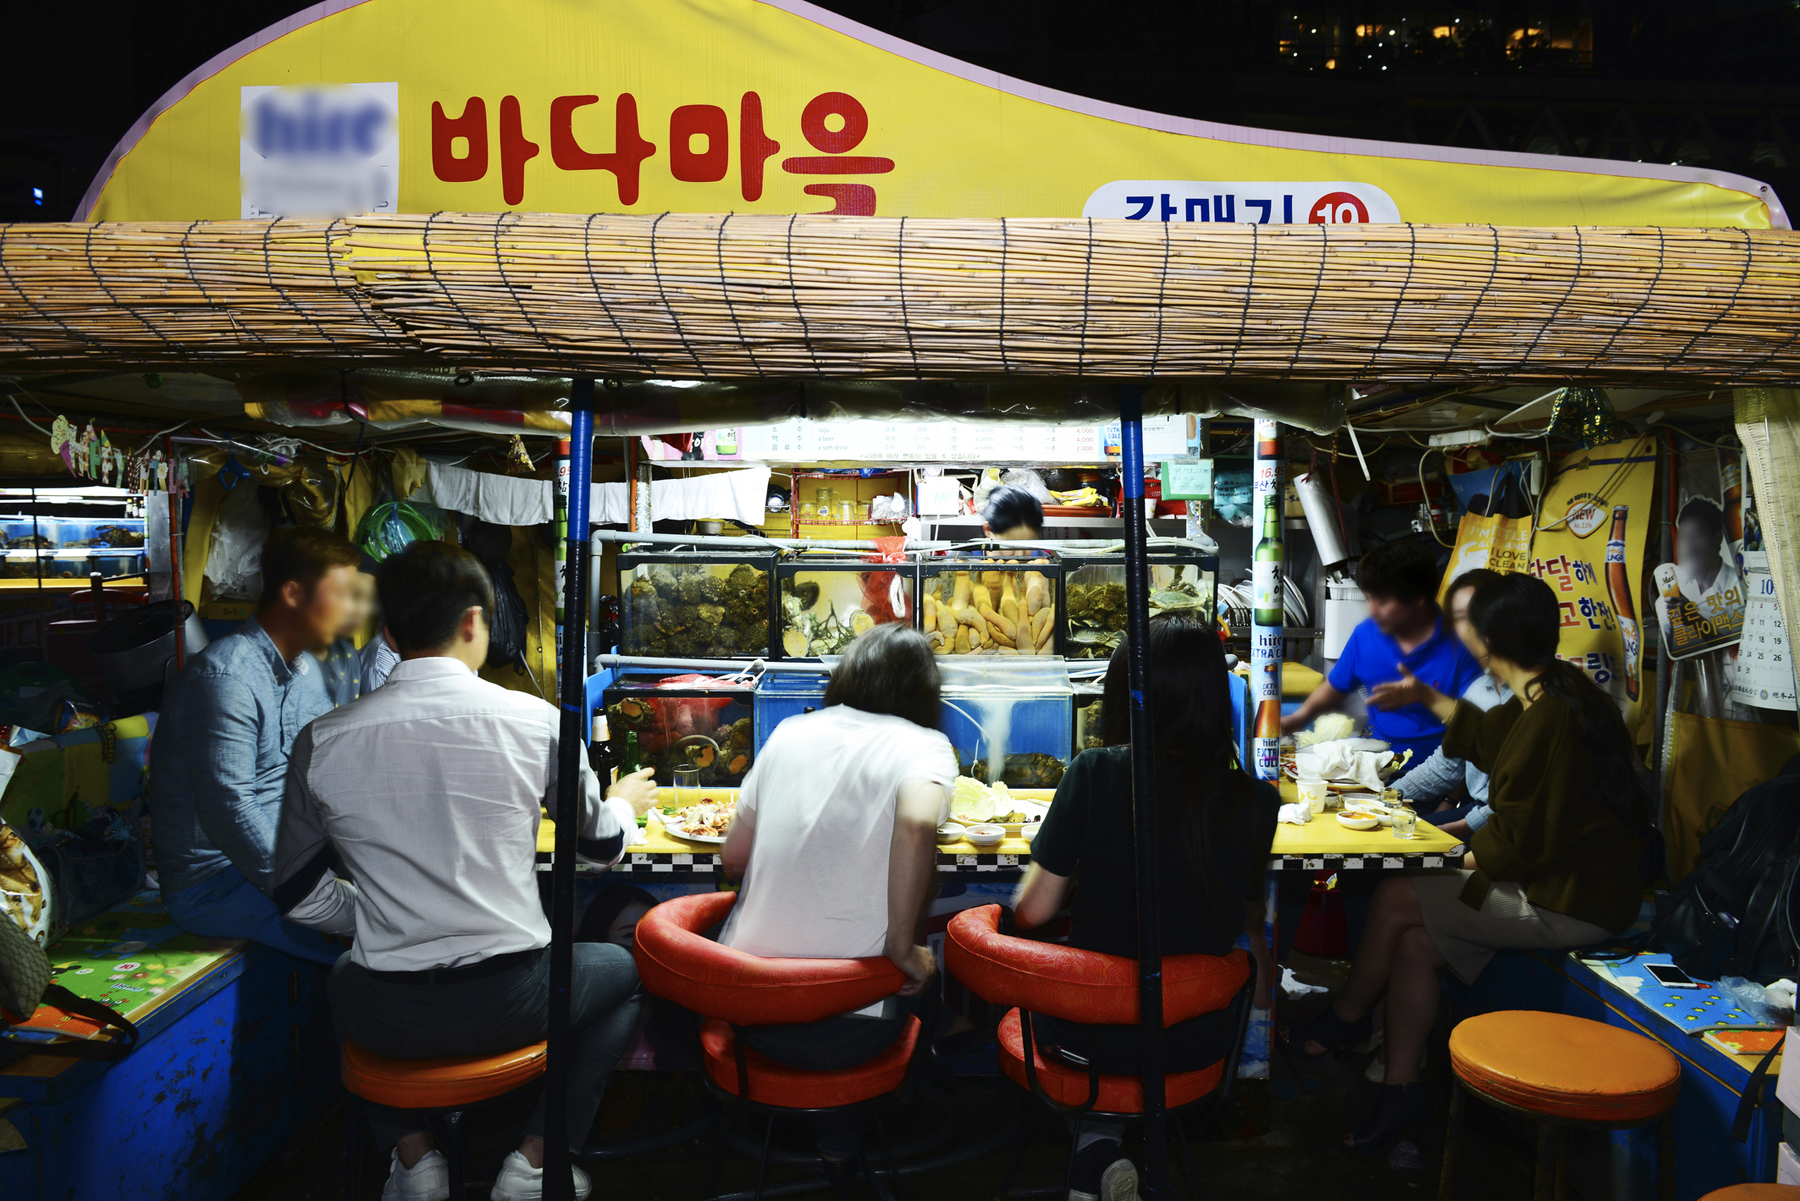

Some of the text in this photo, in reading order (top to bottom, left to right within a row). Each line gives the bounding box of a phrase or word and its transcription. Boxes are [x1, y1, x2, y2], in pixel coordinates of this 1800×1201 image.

[432, 90, 895, 217] 바다마을
[1572, 508, 1596, 521] NEW
[1491, 525, 1528, 541] ITTLE
[1504, 542, 1528, 551] AND
[1496, 550, 1526, 561] LOVE
[1489, 558, 1525, 571] CLEAN
[1760, 579, 1774, 596] 10
[1667, 586, 1742, 627] 깊은 맛의
[1773, 603, 1779, 611] 5
[1673, 610, 1745, 647] 클라이맥스
[1773, 620, 1782, 628] 12
[1259, 634, 1282, 647] hite
[1758, 635, 1765, 643] 18
[1773, 637, 1782, 645] 19
[1757, 652, 1765, 660] 25
[1773, 654, 1782, 662] 26
[1262, 739, 1278, 747] hite
